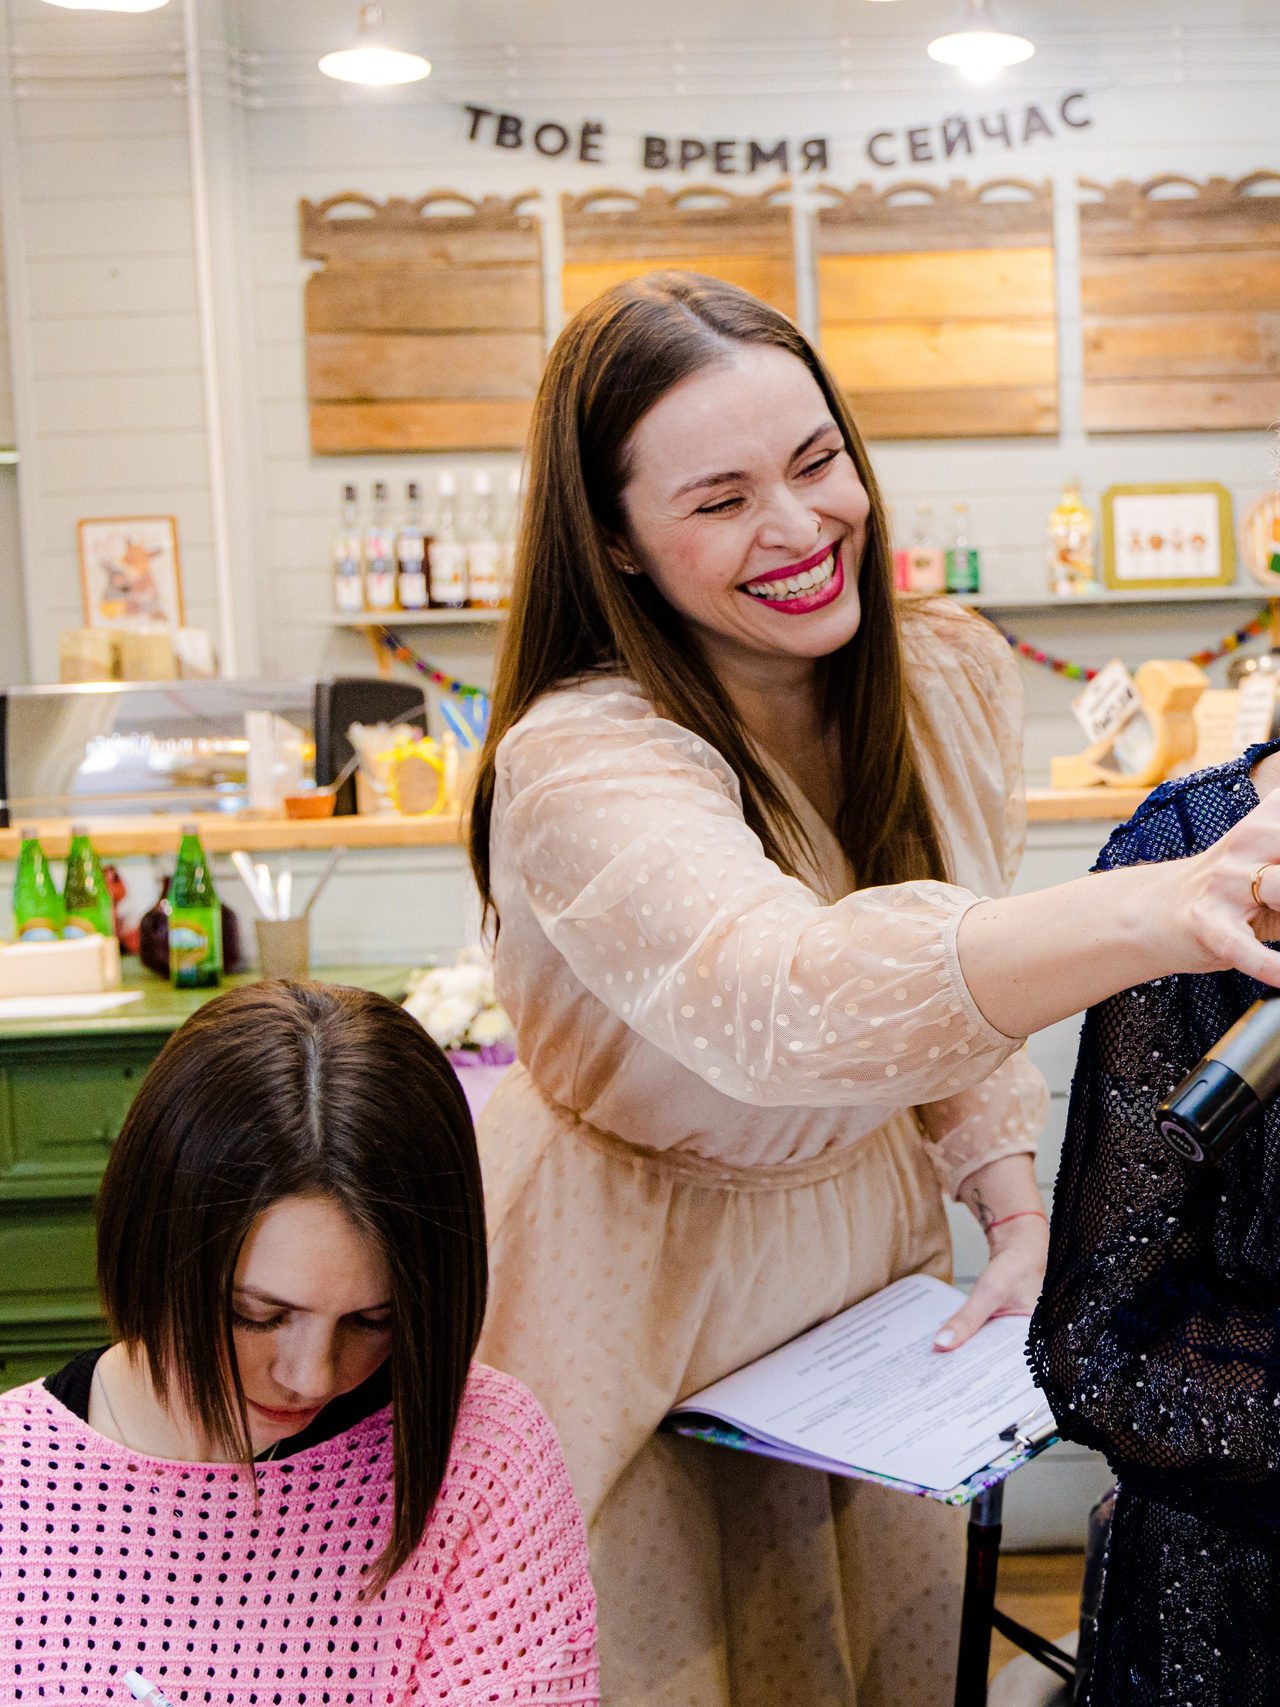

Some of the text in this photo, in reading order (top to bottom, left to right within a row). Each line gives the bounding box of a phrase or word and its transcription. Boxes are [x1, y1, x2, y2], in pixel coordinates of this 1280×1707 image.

[462, 93, 1092, 175] ТВОЁ ВРЕМЯ СЕЙЧАС
